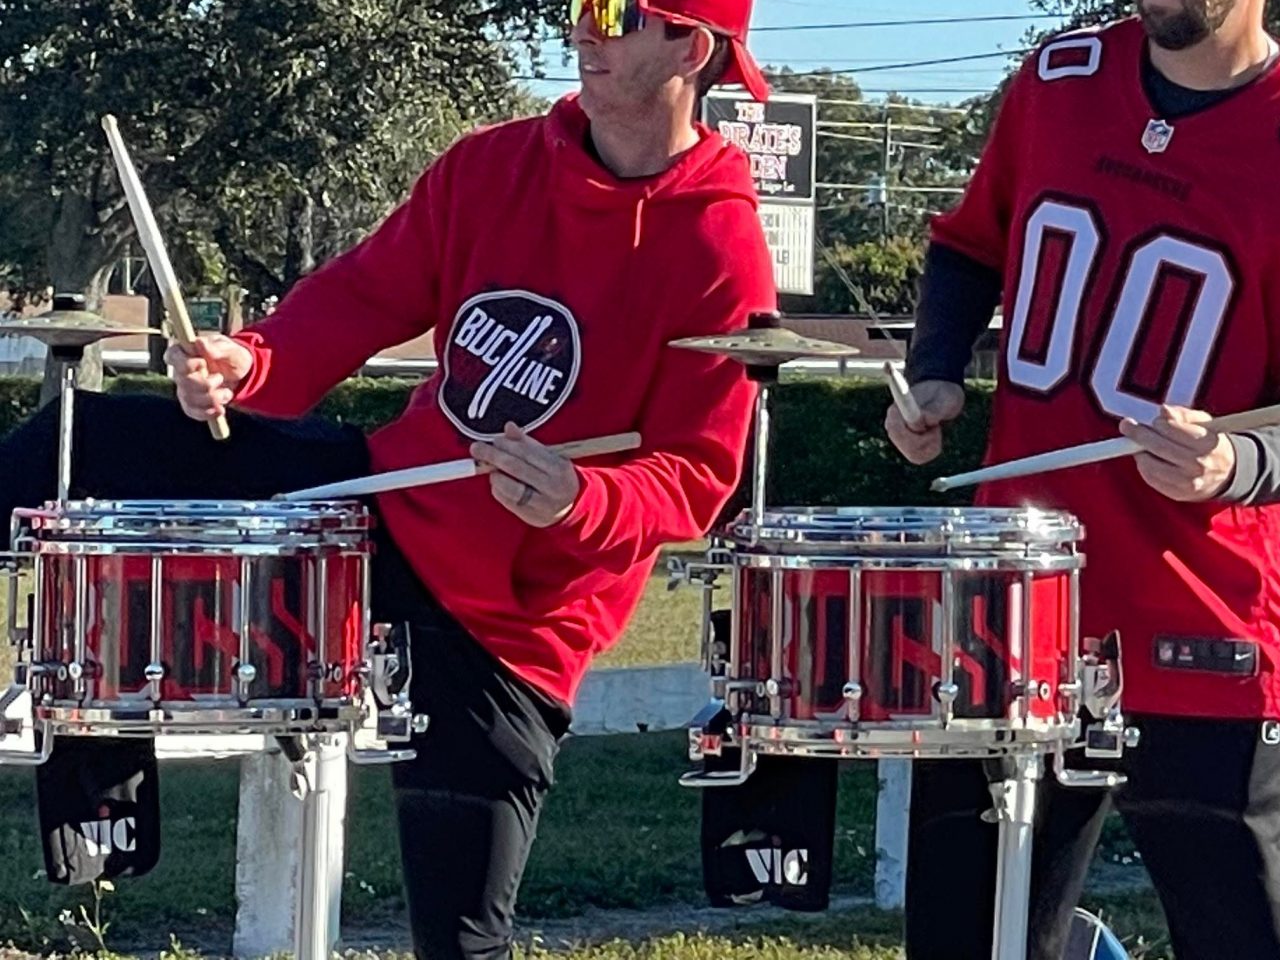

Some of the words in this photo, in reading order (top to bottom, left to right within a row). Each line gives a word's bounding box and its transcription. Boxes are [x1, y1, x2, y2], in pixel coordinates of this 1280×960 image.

[734, 101, 765, 123] THE
[750, 154, 788, 180] DEN
[1004, 197, 1238, 427] 00
[454, 306, 519, 366] BUC
[502, 356, 564, 406] LINE
[79, 816, 137, 858] VIC
[744, 848, 808, 886] VIC
